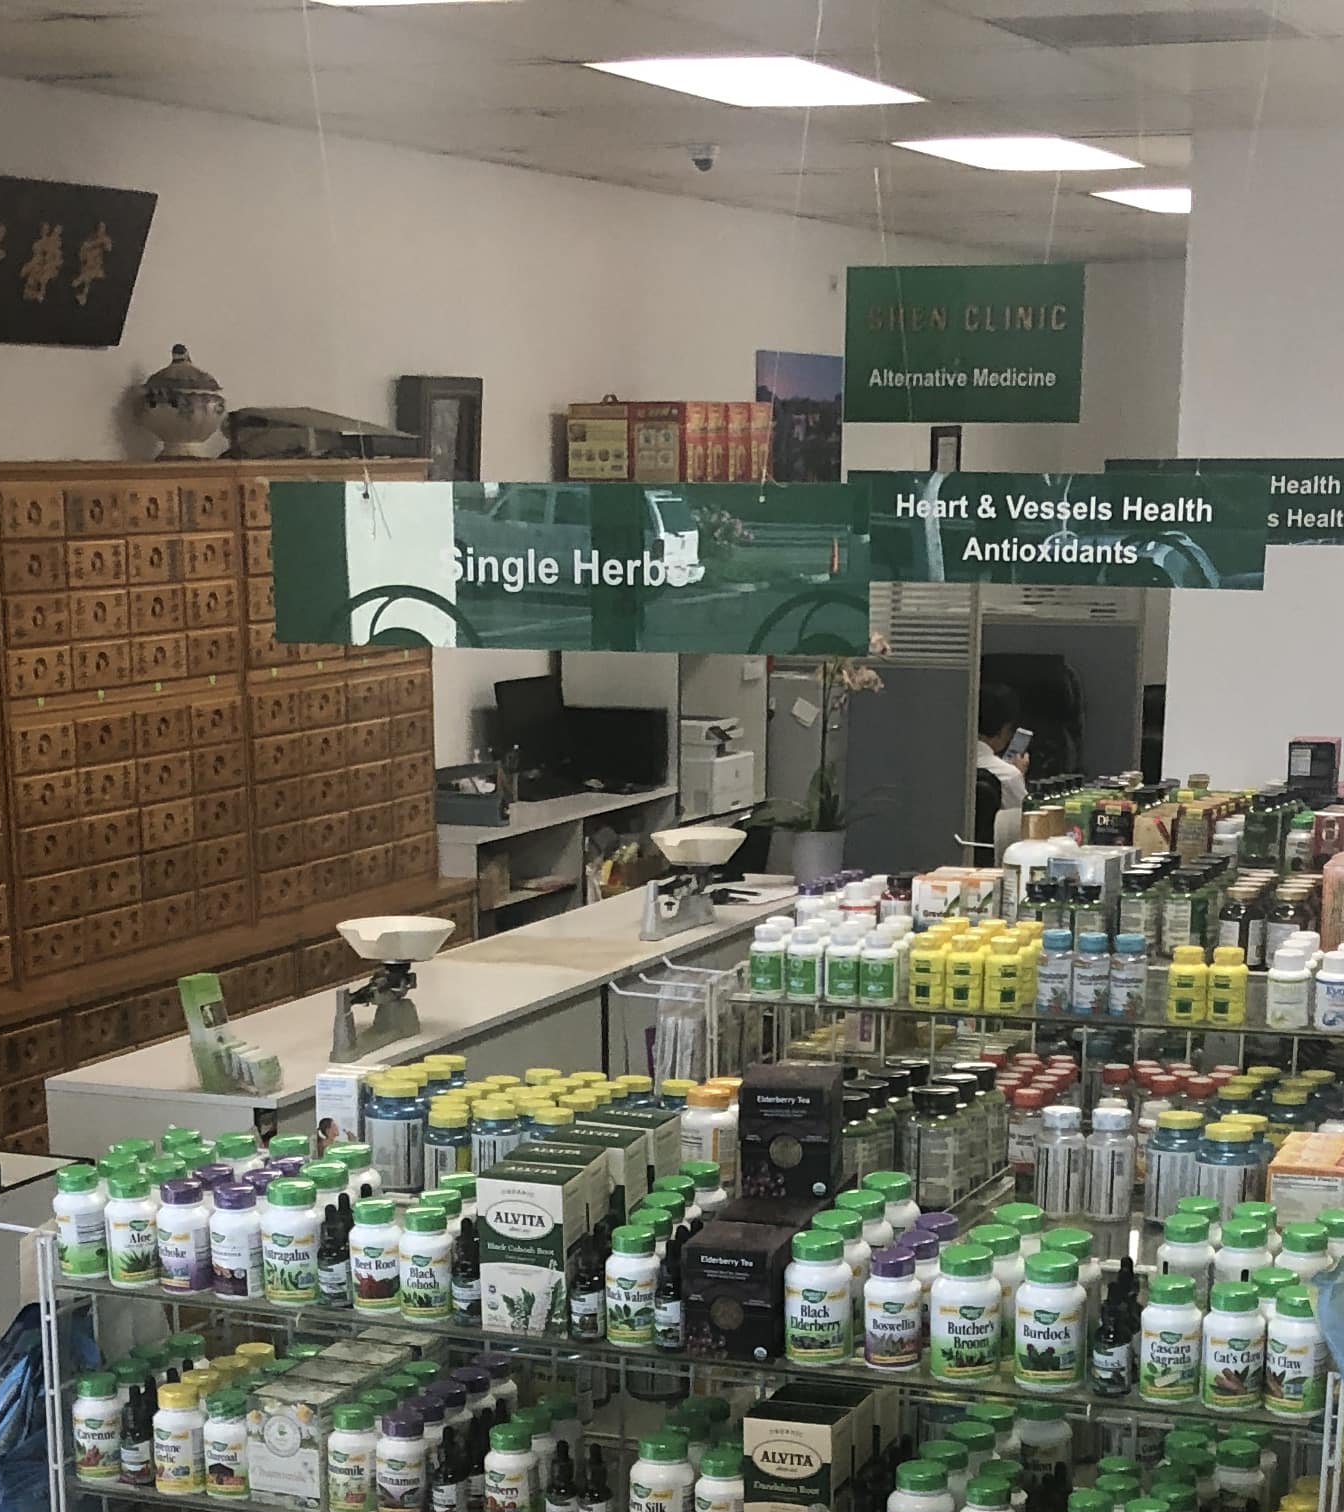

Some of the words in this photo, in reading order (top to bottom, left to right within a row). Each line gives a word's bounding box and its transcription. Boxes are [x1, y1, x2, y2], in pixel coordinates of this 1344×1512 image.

[868, 305, 945, 331] SHEN
[964, 304, 1067, 331] CLINIC
[869, 368, 966, 388] Alternative
[973, 368, 1056, 387] Medicine
[1270, 475, 1340, 495] Health
[896, 495, 970, 519] Heart
[976, 496, 997, 519] &
[1006, 495, 1112, 521] Vessels
[1122, 497, 1213, 523] Health
[962, 536, 1138, 565] Antioxidants
[447, 545, 553, 587] Single
[573, 549, 689, 587] Herbs
[493, 1211, 545, 1229] ALVITA
[130, 1232, 151, 1244] Aloe
[375, 1259, 396, 1270] Root
[701, 1255, 738, 1267] Elderberry
[740, 1258, 753, 1267] Tea
[410, 1267, 435, 1279] Black
[407, 1277, 439, 1290] Cohosh
[801, 1304, 830, 1318] Black
[791, 1315, 841, 1331] Elderberry
[872, 1319, 915, 1331] Boswellia
[948, 1321, 994, 1336] Butcher's
[1023, 1324, 1071, 1341] Burdock
[954, 1336, 989, 1350] Broom
[1151, 1342, 1191, 1354] Cascara
[1151, 1354, 1191, 1366] Sagrada
[1214, 1351, 1236, 1363] Cat's
[1278, 1357, 1301, 1369] Claw
[77, 1429, 116, 1441] Cayenne
[760, 1450, 813, 1469] ALVITA
